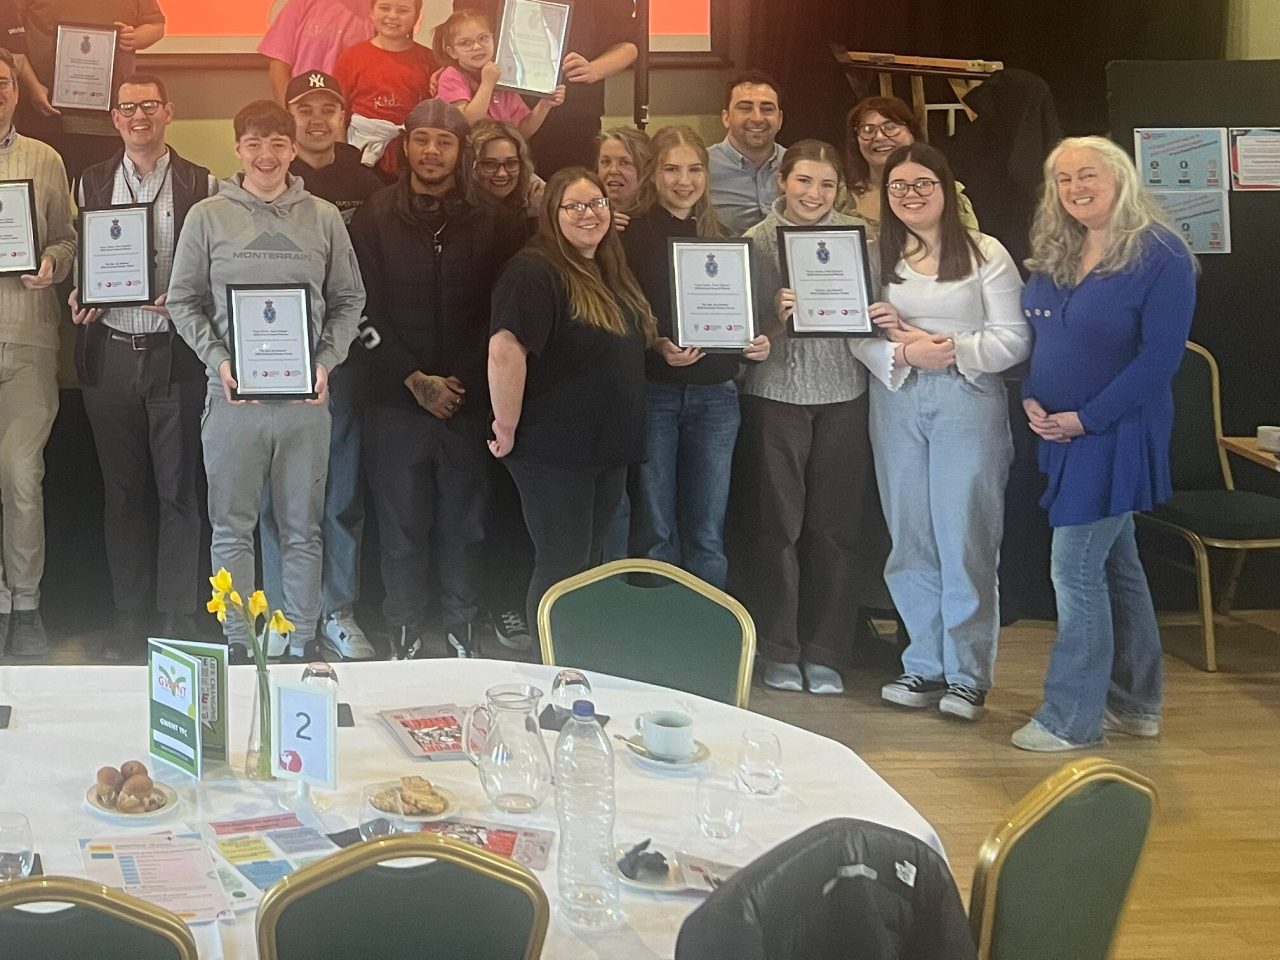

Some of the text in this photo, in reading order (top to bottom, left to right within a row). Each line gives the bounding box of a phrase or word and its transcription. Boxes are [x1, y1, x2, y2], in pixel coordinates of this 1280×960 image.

[232, 251, 313, 261] MONTERRAIN
[160, 717, 179, 732] GWENT
[295, 711, 312, 741] 2
